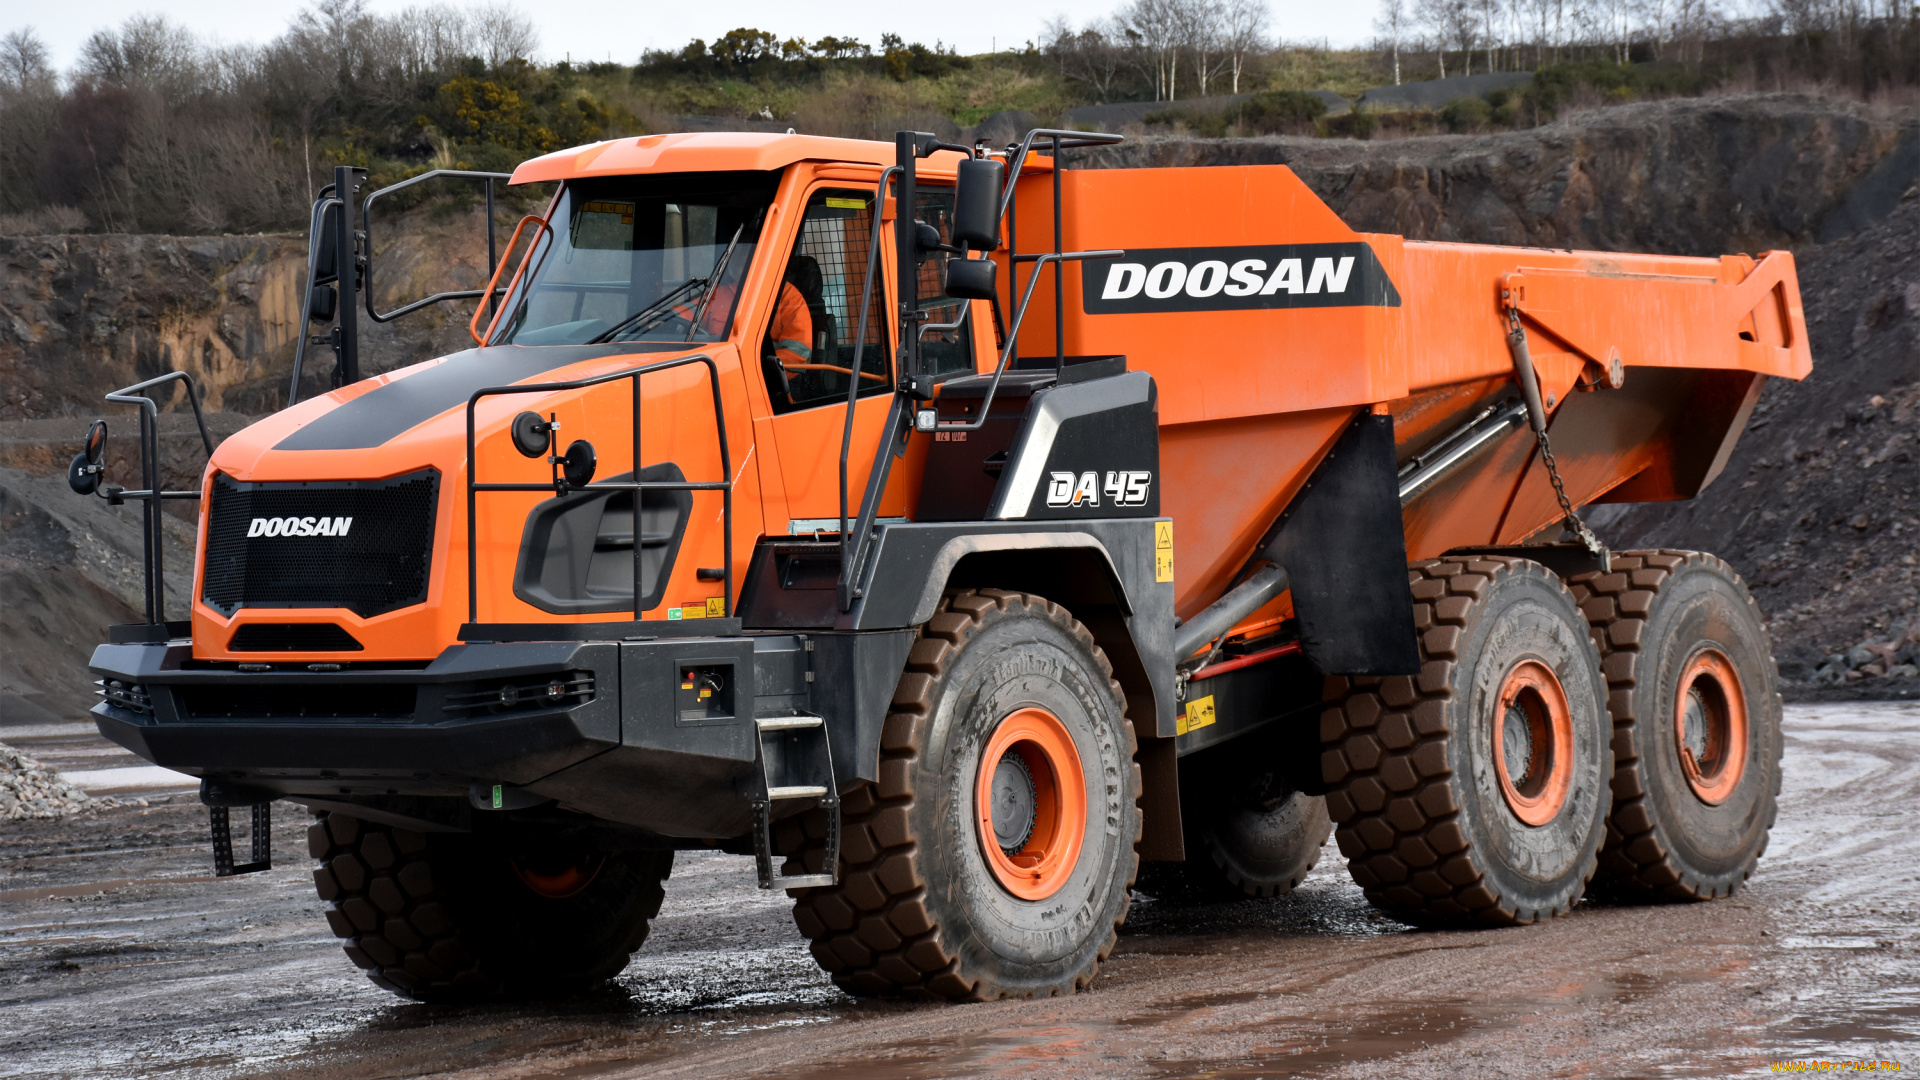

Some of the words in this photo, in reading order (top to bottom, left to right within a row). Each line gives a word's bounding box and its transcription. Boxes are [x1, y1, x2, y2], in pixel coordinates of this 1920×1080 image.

[1101, 256, 1355, 300] DOOSAN
[1047, 471, 1100, 508] DA
[1104, 471, 1152, 507] 45
[247, 516, 353, 538] DOOSAN
